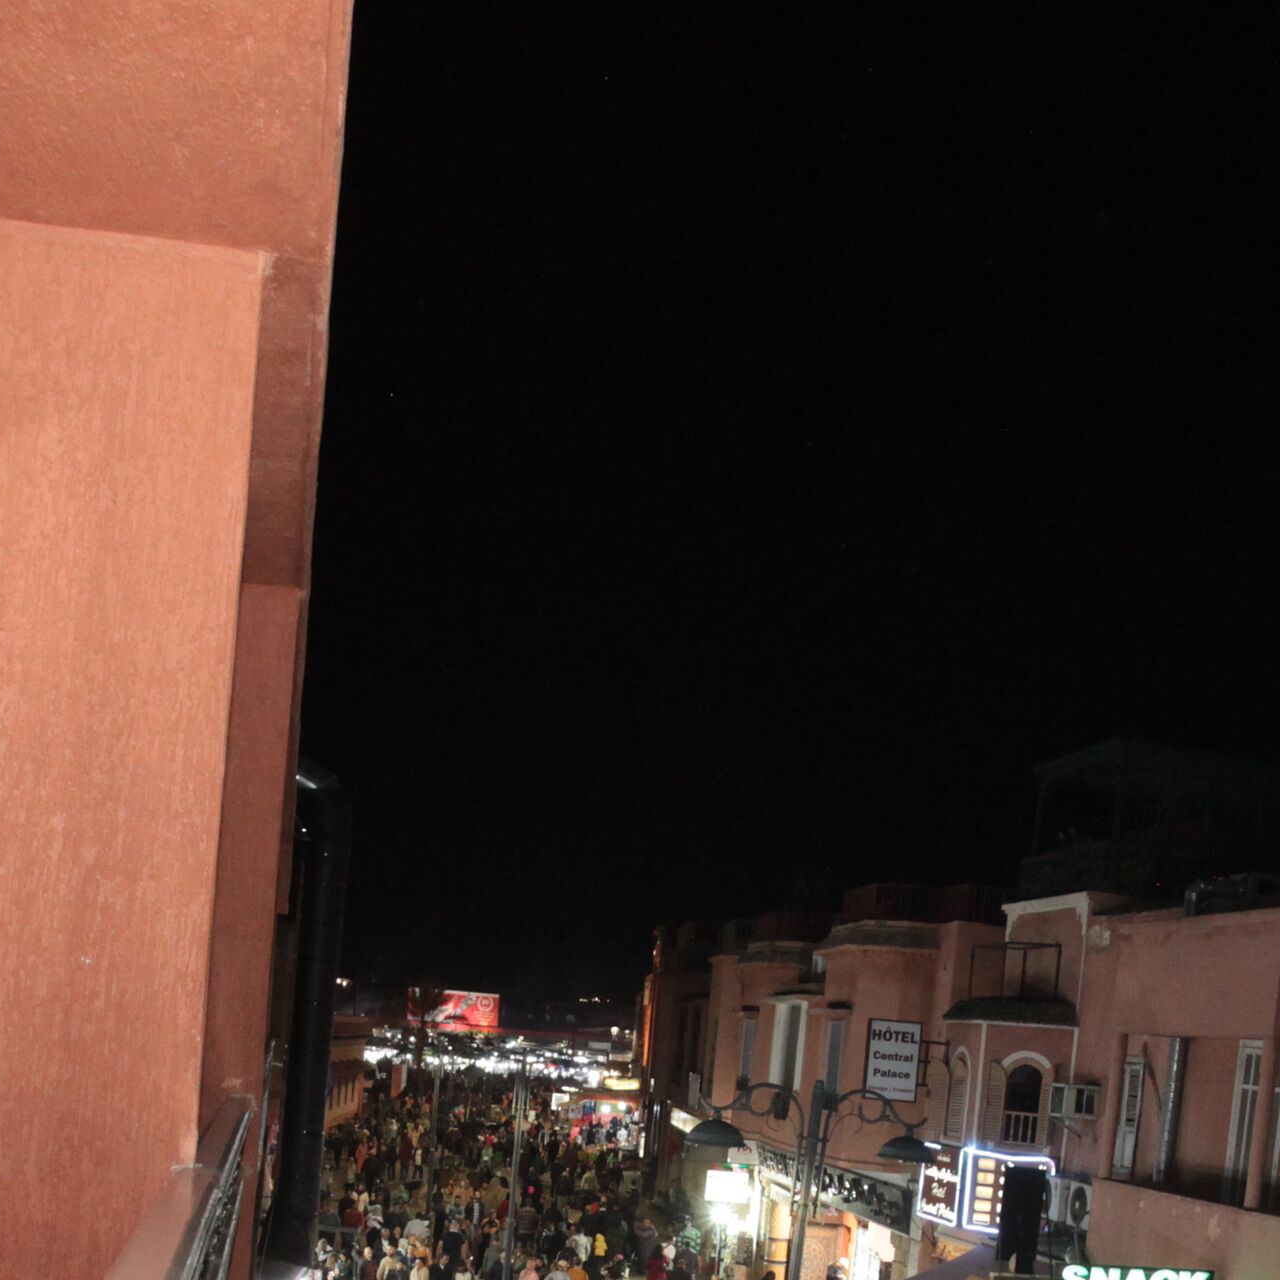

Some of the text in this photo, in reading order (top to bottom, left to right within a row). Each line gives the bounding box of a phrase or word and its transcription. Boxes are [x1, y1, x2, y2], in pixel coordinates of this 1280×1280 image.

[872, 1026, 918, 1044] HÔTEL
[873, 1051, 914, 1062] Central
[873, 1068, 911, 1079] Palace
